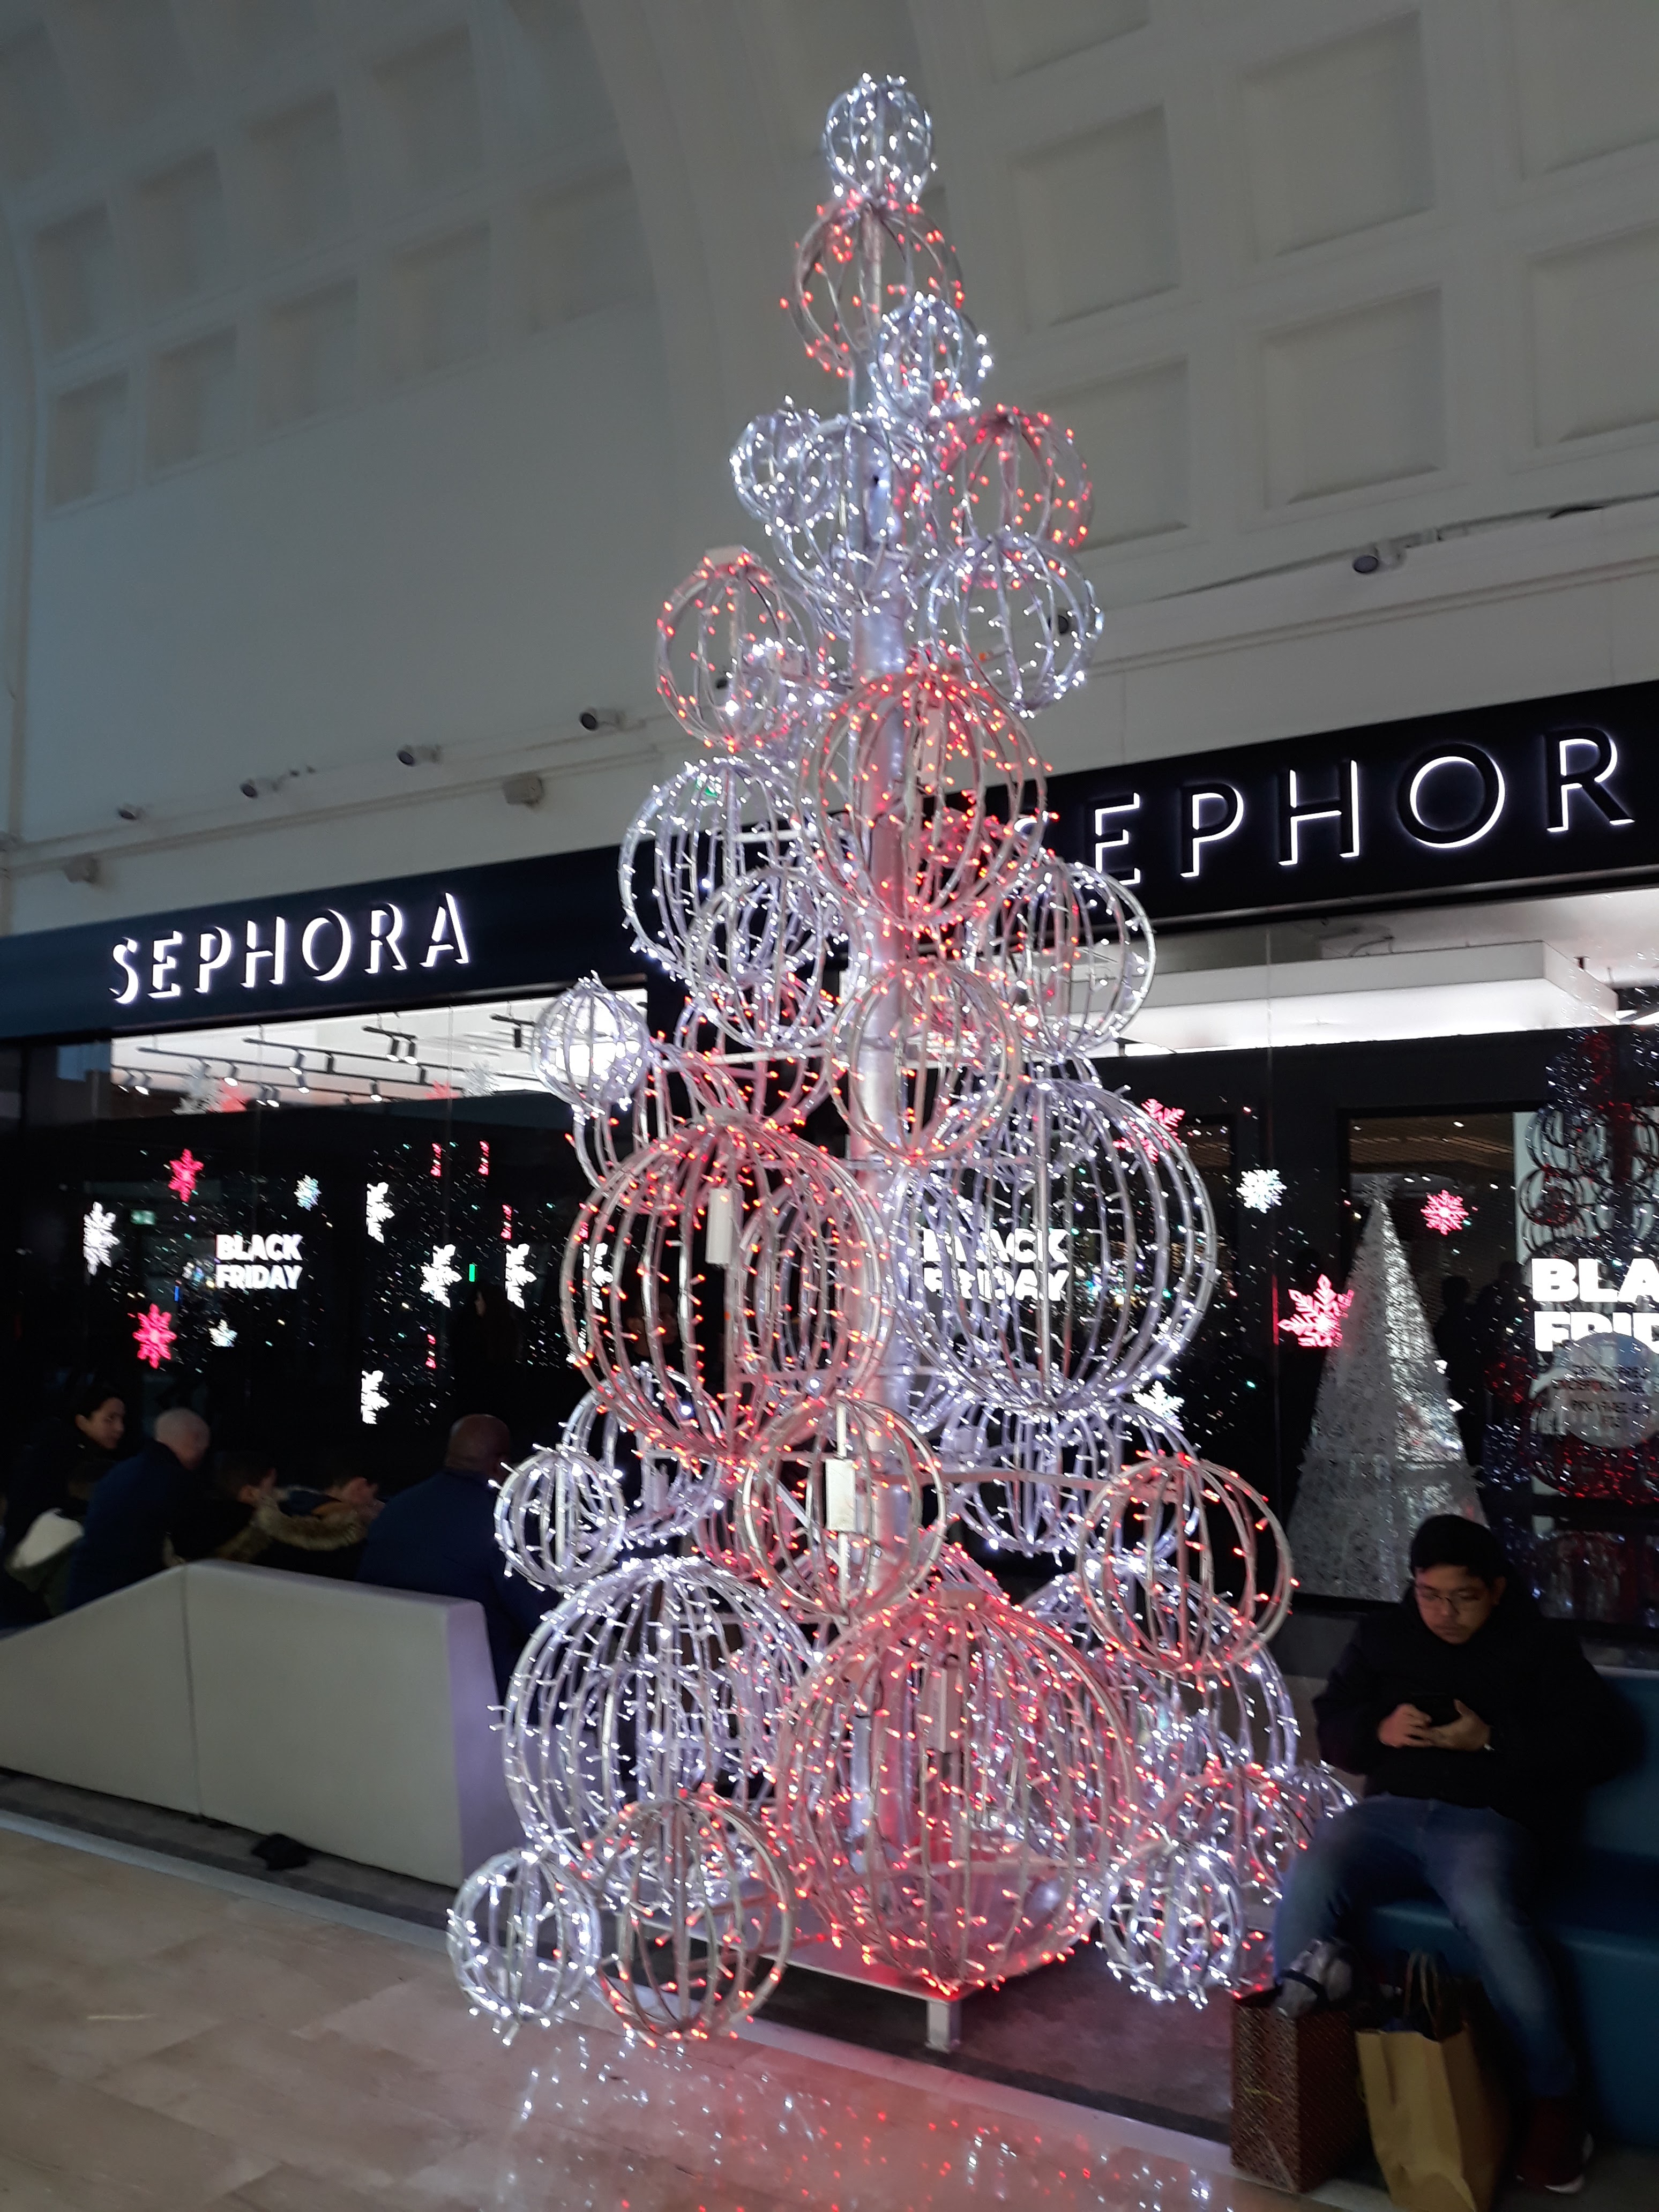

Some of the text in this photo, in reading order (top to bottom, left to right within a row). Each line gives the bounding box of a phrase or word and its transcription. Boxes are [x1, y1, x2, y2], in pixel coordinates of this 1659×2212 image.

[109, 892, 472, 1004] SEPHORA
[215, 1234, 303, 1261] BLACK
[215, 1265, 303, 1290] FRIDAY
